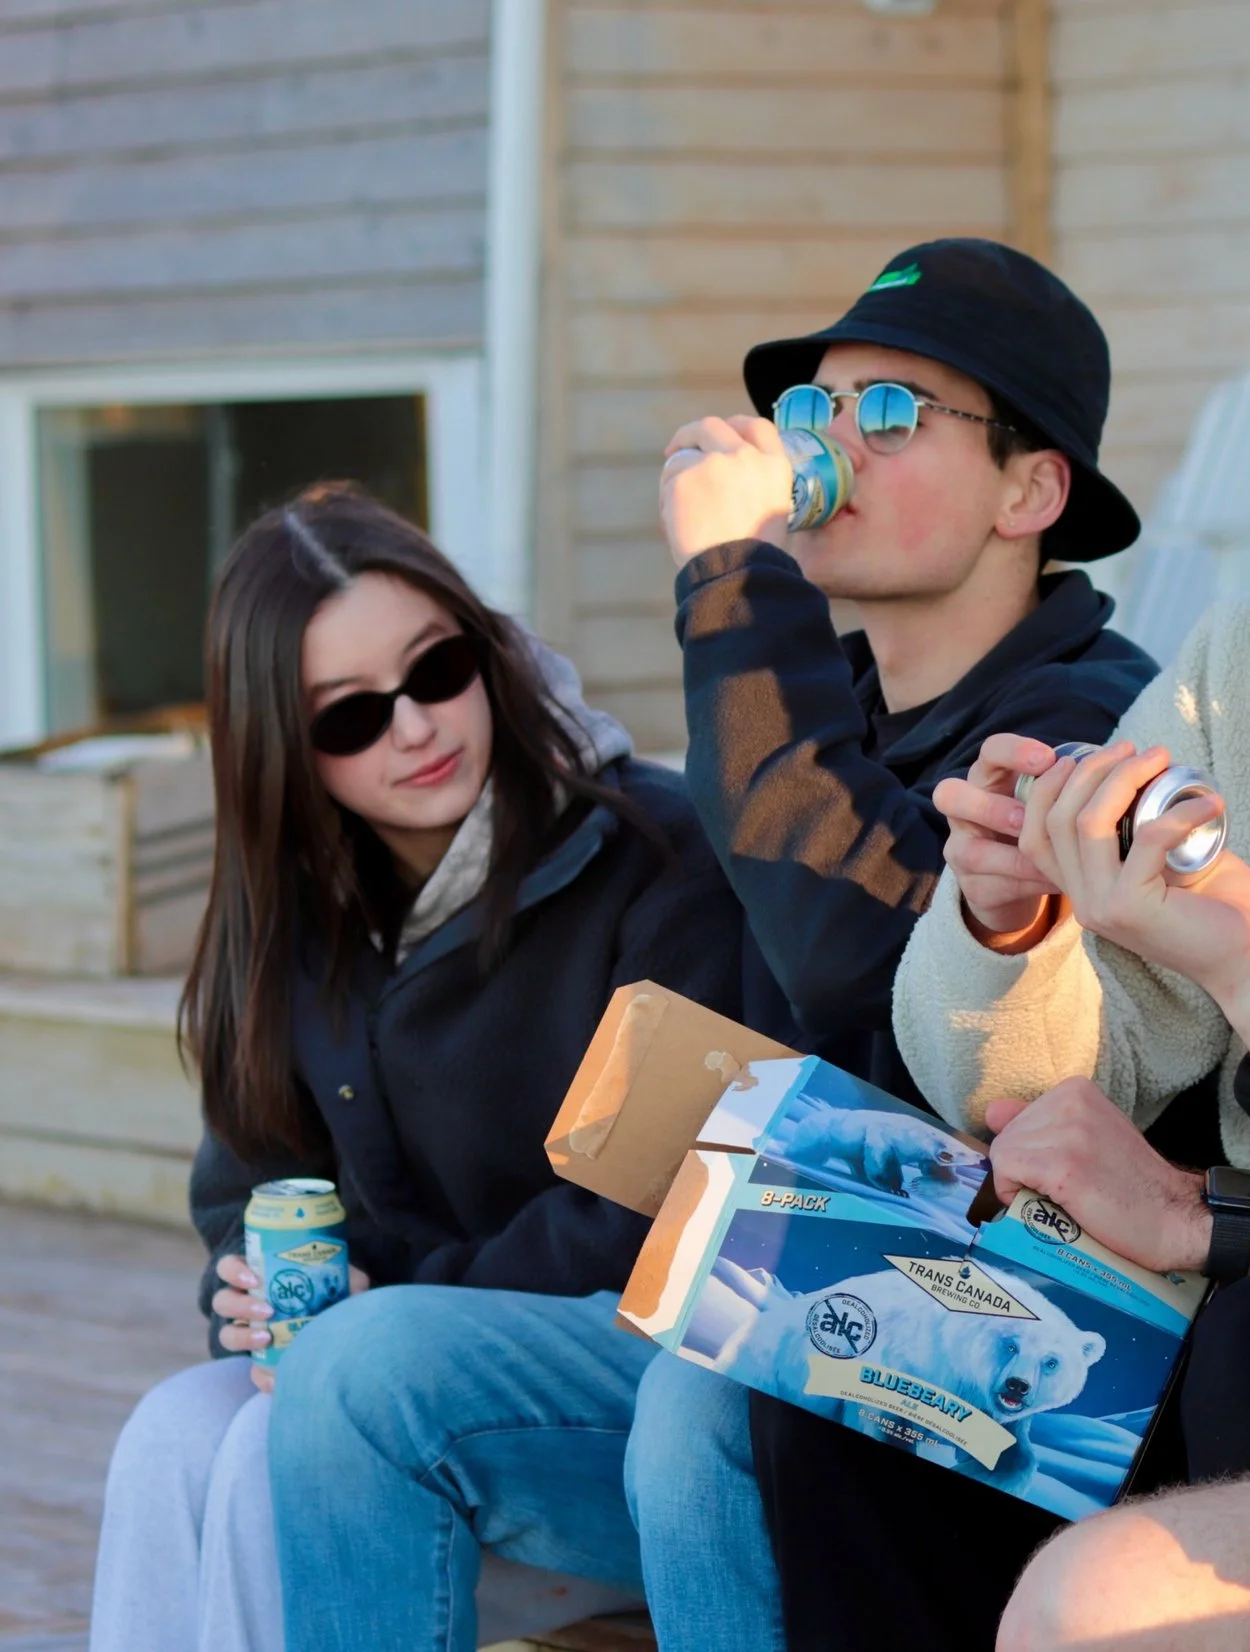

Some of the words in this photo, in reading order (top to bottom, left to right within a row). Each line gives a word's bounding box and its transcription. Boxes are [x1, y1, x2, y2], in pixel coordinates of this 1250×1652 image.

[760, 1190, 831, 1212] 8-PACK
[1065, 1252, 1091, 1269] CANS
[908, 1261, 952, 1288] TRANS
[955, 1280, 1012, 1313] CANADA
[931, 1283, 968, 1306] BREWING
[842, 1299, 872, 1341] DEALCOHOLIZED
[840, 1390, 888, 1408] DEALCOHOLIZED
[859, 1366, 973, 1423] BLUEBEARY
[867, 1411, 896, 1430] CANS
[904, 1427, 924, 1441] 355
